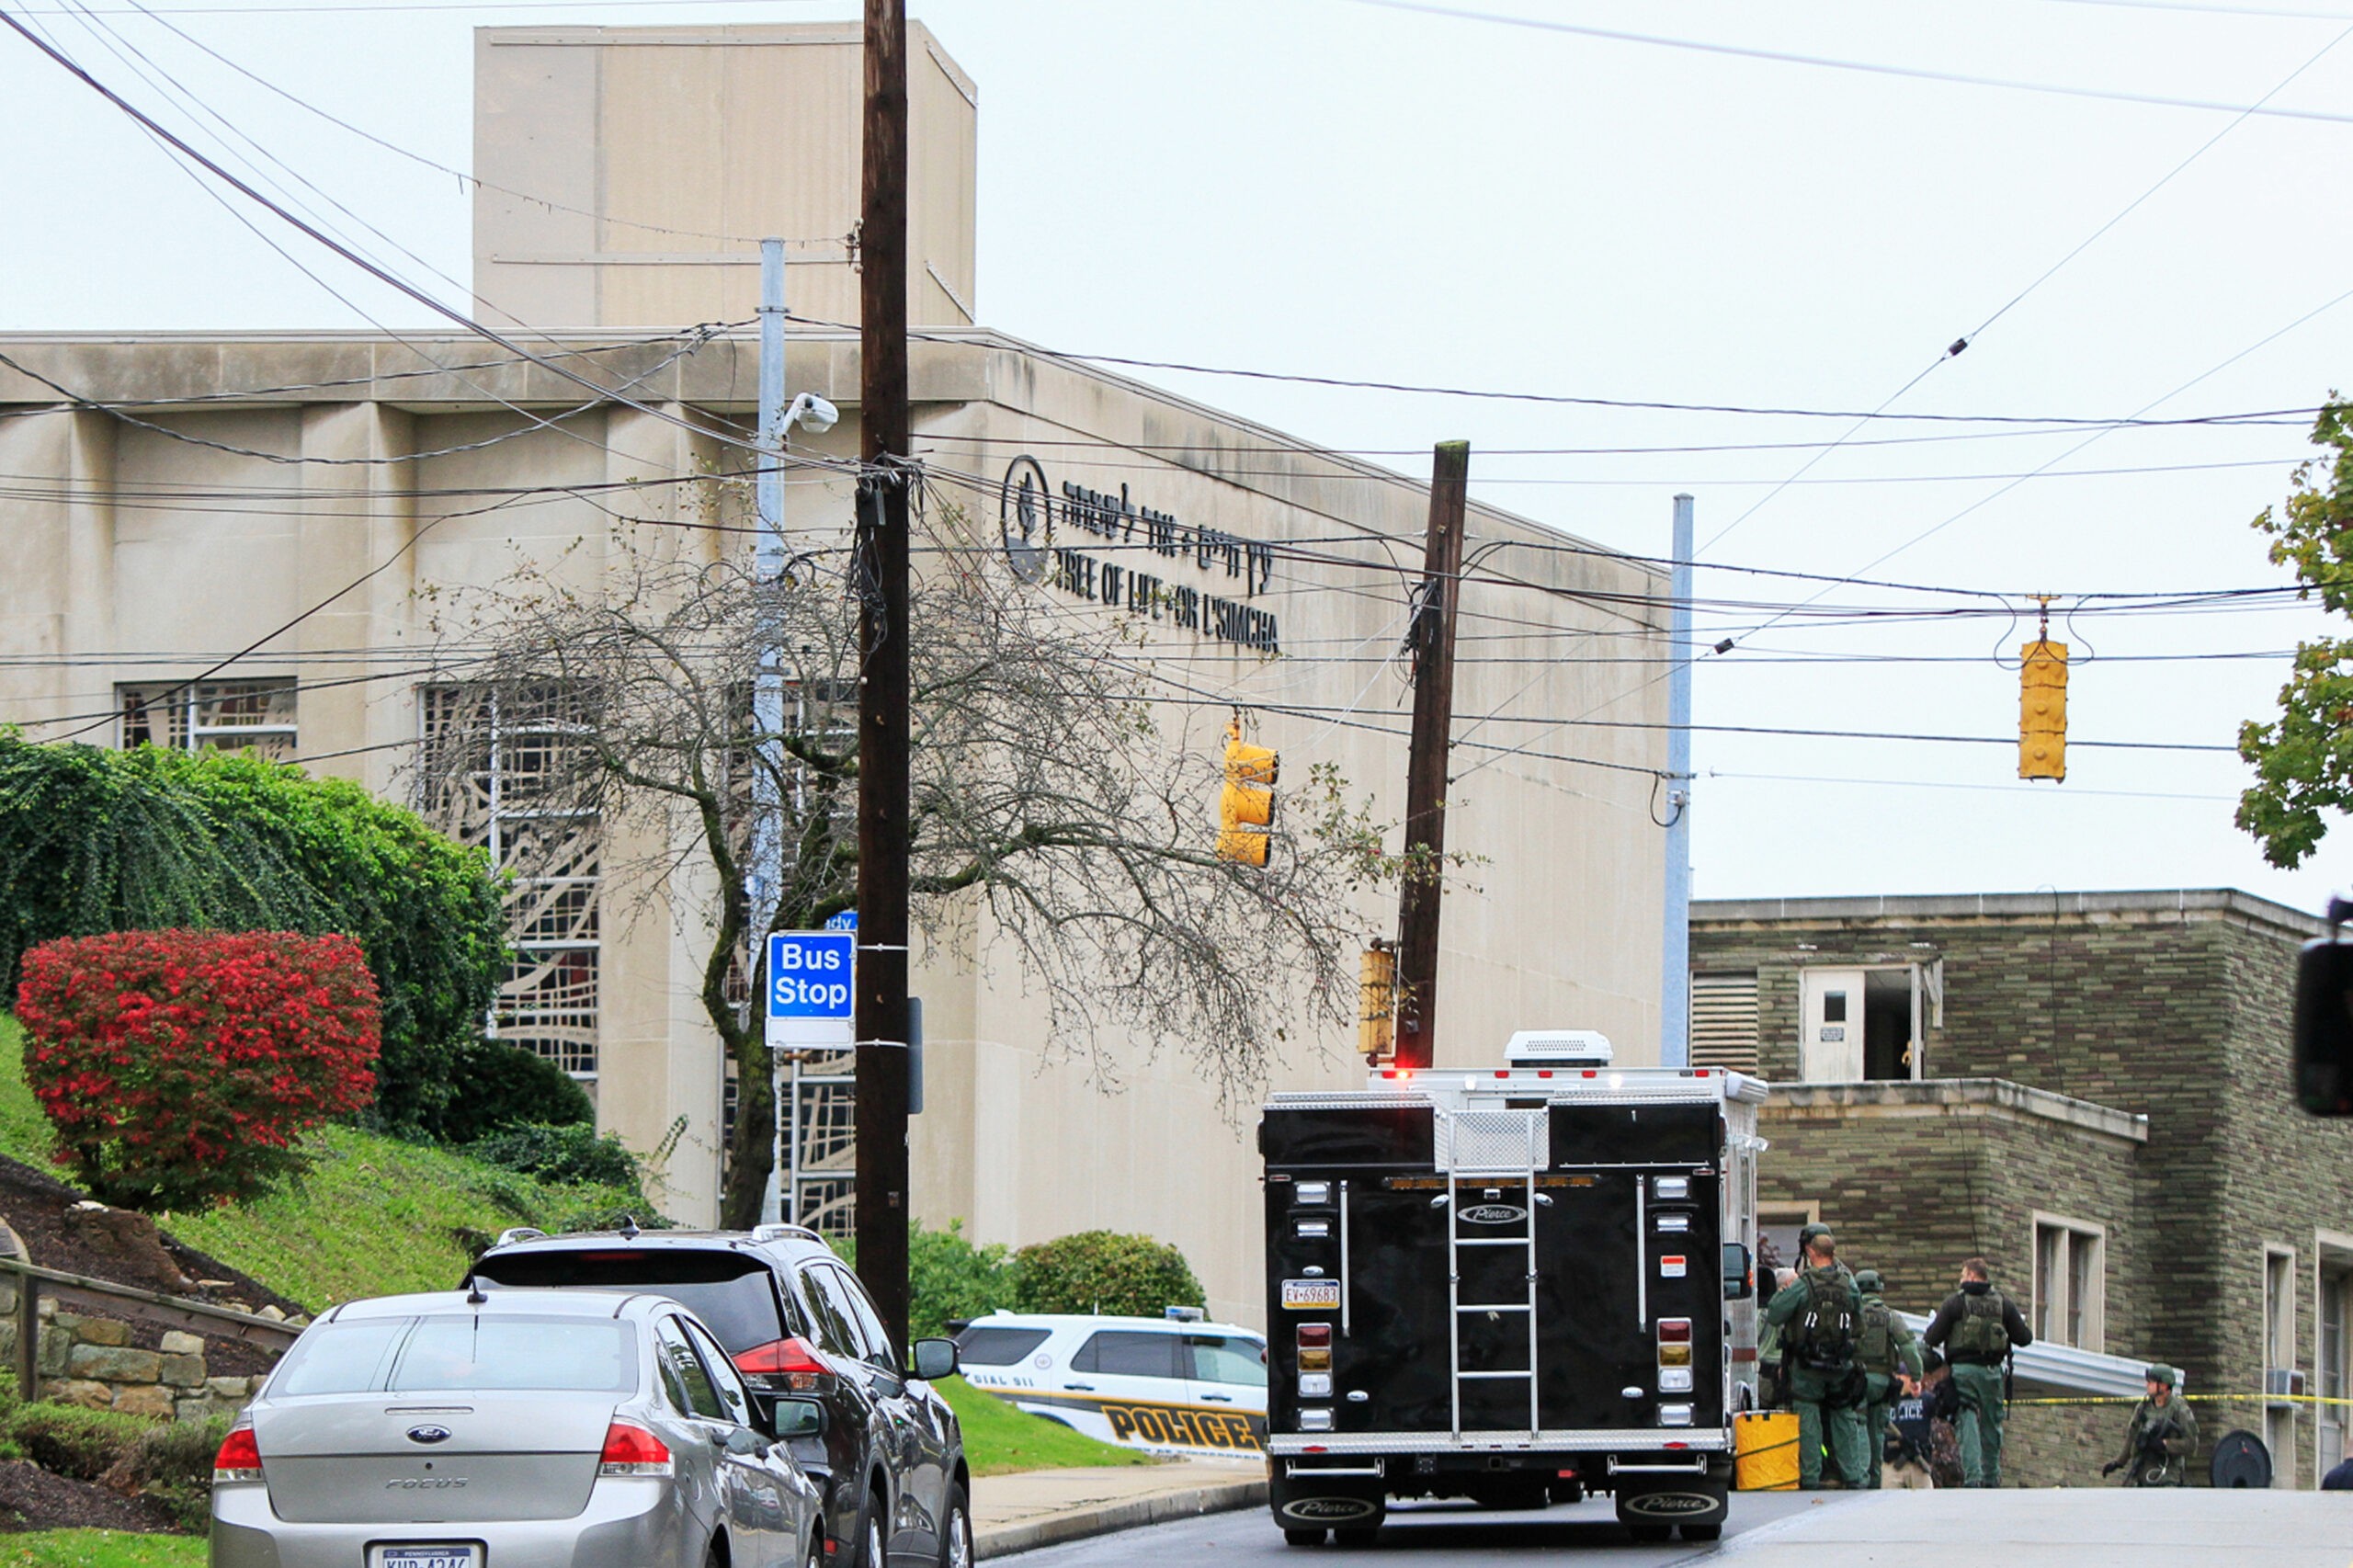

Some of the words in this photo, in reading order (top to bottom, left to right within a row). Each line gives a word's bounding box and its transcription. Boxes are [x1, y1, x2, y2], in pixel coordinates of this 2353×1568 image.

[1054, 549, 1097, 600] TREE
[1102, 562, 1125, 606] OF
[1129, 570, 1163, 619] LIFE
[1175, 585, 1198, 630] OR
[782, 943, 841, 971] Bus
[775, 977, 847, 1009] Stop
[1472, 1207, 1511, 1220] Pierce
[974, 1375, 1006, 1385] DIAL
[1013, 1377, 1034, 1387] 911
[1889, 1405, 1924, 1421] OLICE
[1102, 1406, 1263, 1451] POLICE
[386, 1477, 469, 1489] FOCUS
